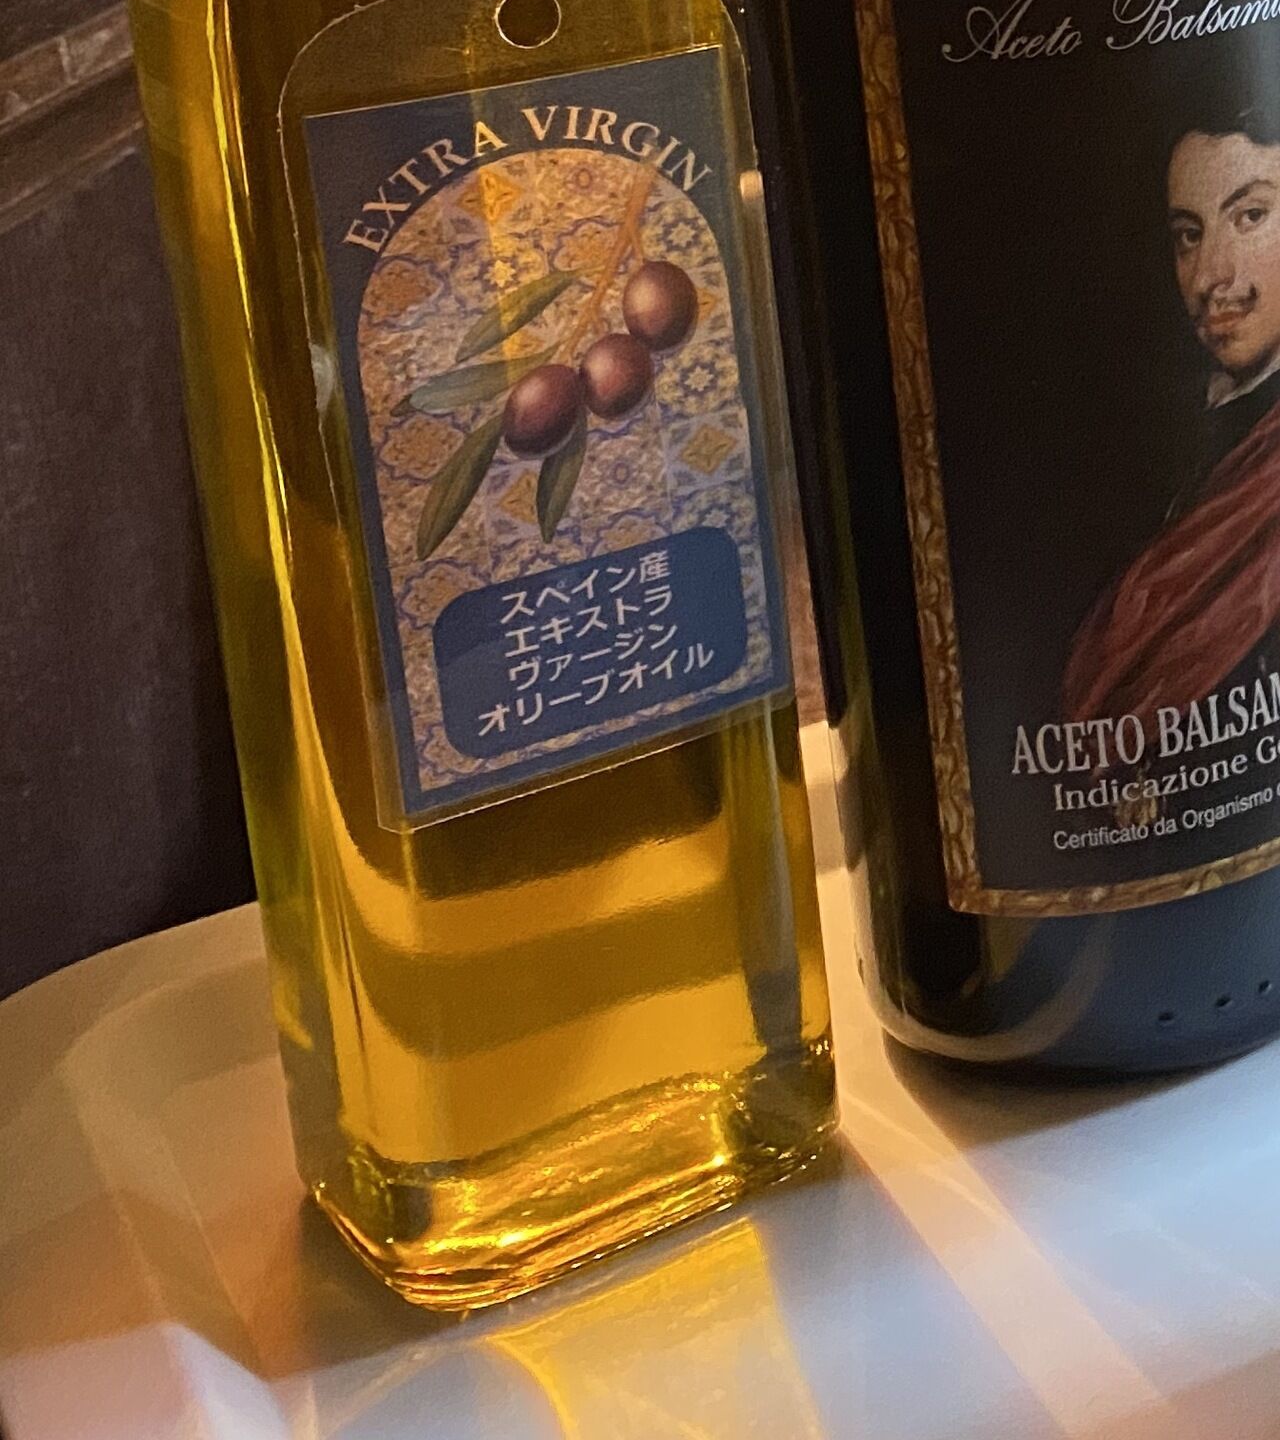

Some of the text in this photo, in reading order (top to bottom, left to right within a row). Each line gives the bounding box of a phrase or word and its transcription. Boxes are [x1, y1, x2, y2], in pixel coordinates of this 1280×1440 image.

[342, 104, 713, 254] EXTRA VIRGIN
[501, 549, 673, 624] スペイン産
[505, 584, 673, 660] エキストラ
[477, 640, 715, 738] オリーブオイル
[508, 622, 680, 692] ヴァージン
[1011, 713, 1145, 775] ACETO
[1054, 752, 1249, 812] Indicazione
[1053, 820, 1150, 851] Certificato
[1153, 816, 1178, 837] da
[1182, 786, 1274, 827] Organismo
